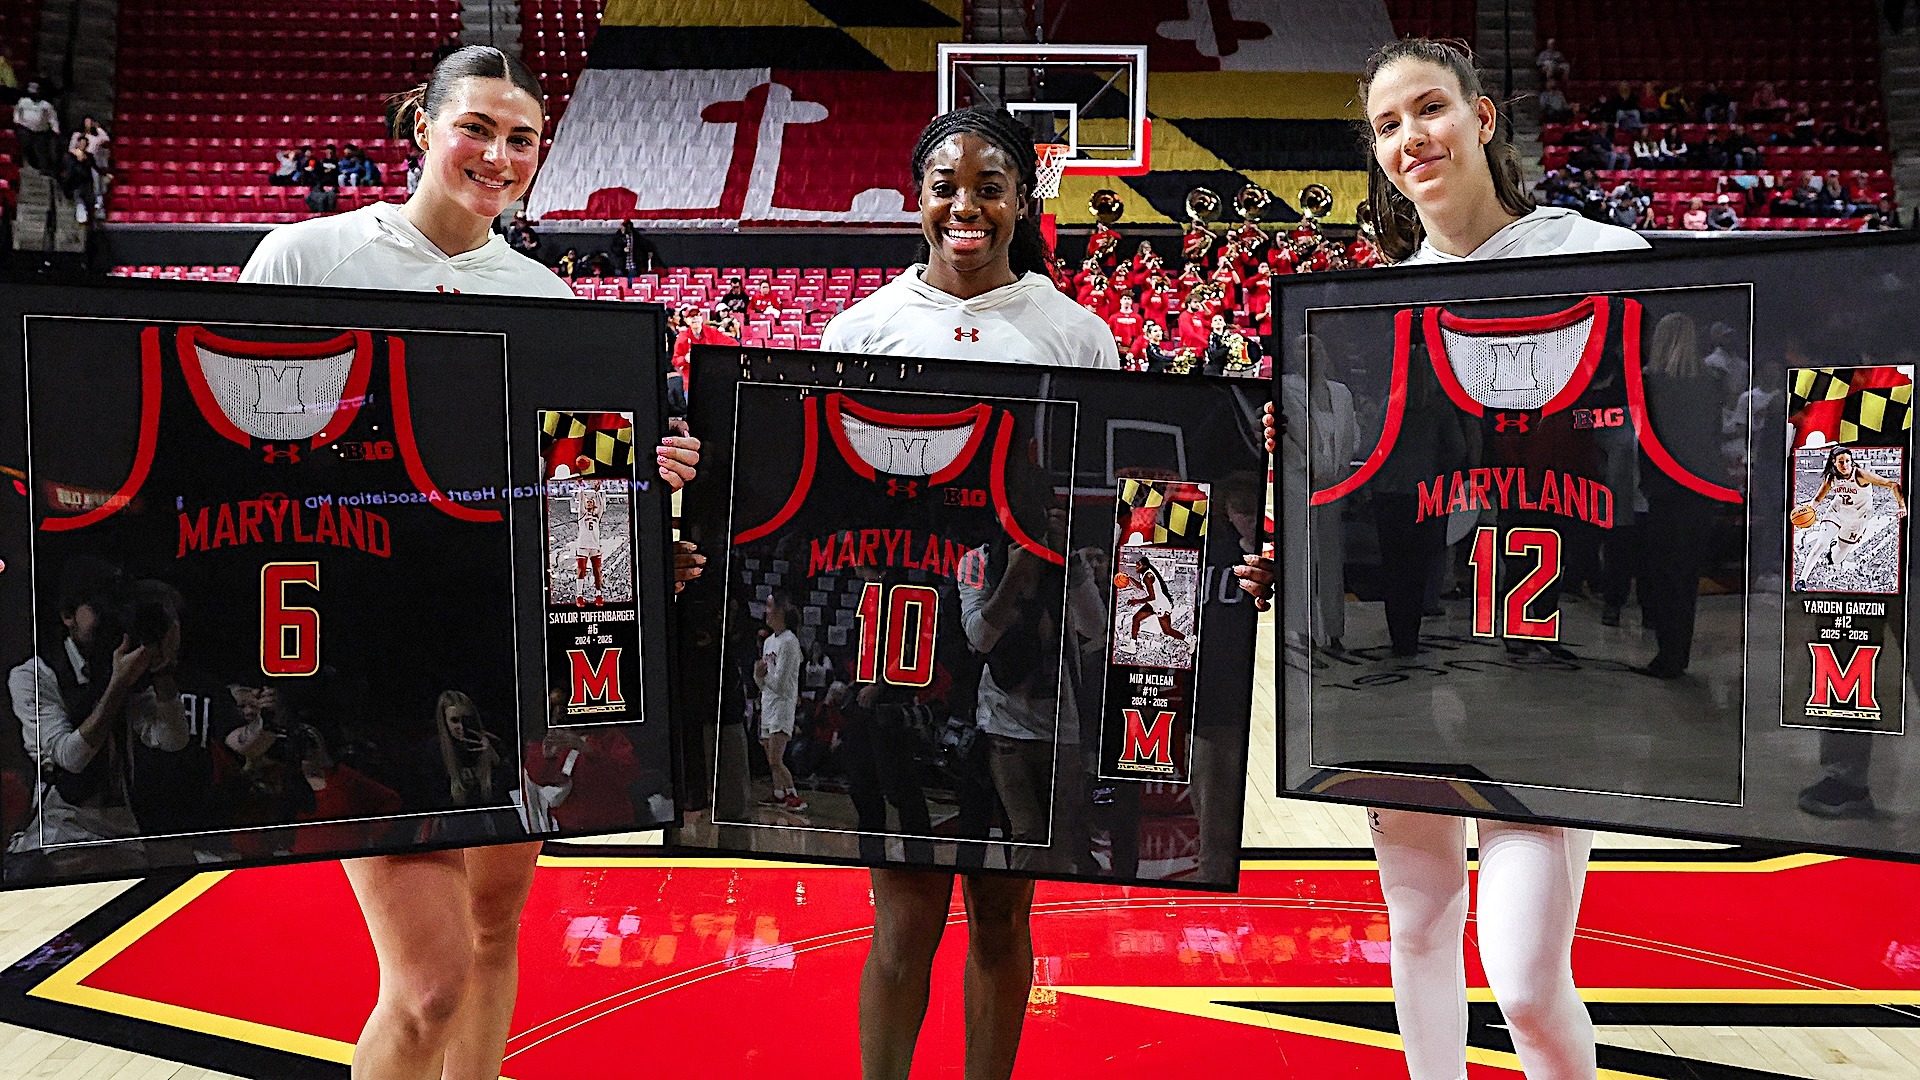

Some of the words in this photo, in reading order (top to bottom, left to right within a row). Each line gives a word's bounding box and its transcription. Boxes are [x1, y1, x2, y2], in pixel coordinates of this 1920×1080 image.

[1416, 467, 1614, 530] MARYLAND
[176, 499, 392, 558] MARYLAND
[806, 529, 985, 590] MARYLAND
[1469, 526, 1562, 642] 12
[260, 561, 320, 677] 6
[549, 611, 578, 624] SAYLOR
[580, 610, 635, 622] POFFENBARGER
[1804, 601, 1843, 614] YARDEN
[1845, 602, 1885, 615] GARZON
[1834, 616, 1852, 629] #12
[575, 636, 591, 645] 2024
[597, 635, 613, 644] 2026
[587, 623, 598, 634] #6
[855, 582, 939, 687] 10
[1821, 629, 1840, 639] 2025
[1848, 630, 1868, 640] 2026
[566, 647, 625, 706] M
[1129, 673, 1144, 684] MIR
[1145, 674, 1174, 686] MCLEAN
[1142, 686, 1158, 696] #10
[1806, 643, 1881, 711] M
[1131, 697, 1147, 706] 2024
[1152, 698, 1168, 707] 2026
[1118, 709, 1176, 765] M
